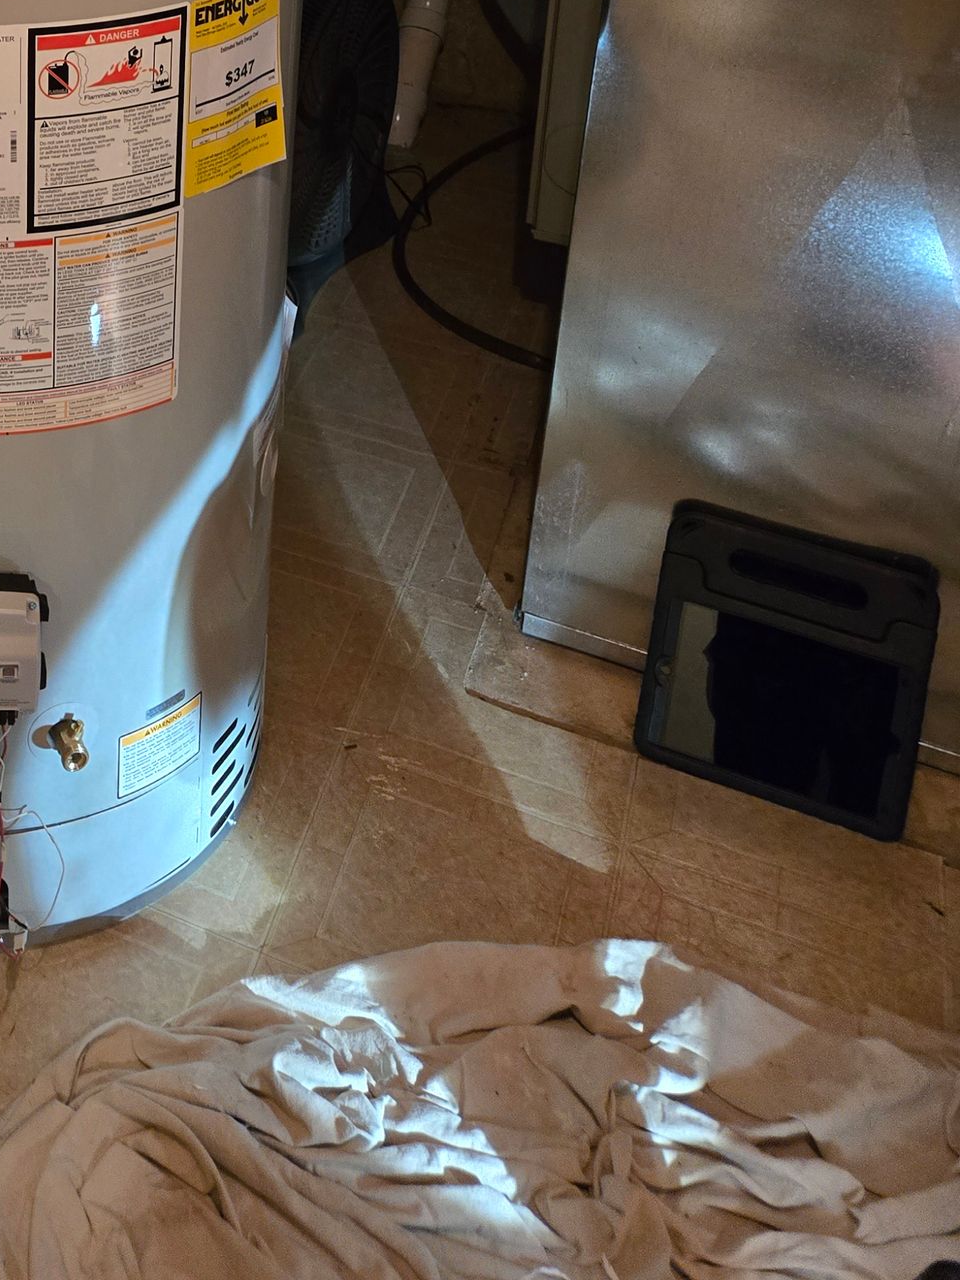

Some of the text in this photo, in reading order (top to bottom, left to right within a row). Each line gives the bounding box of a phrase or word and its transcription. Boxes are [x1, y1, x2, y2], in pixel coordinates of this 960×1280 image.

[100, 29, 140, 42] DANGER
[225, 58, 255, 87] $347
[84, 87, 140, 101] Flammable Vapors
[113, 227, 138, 236] WARNING
[150, 711, 183, 733] WARNING
